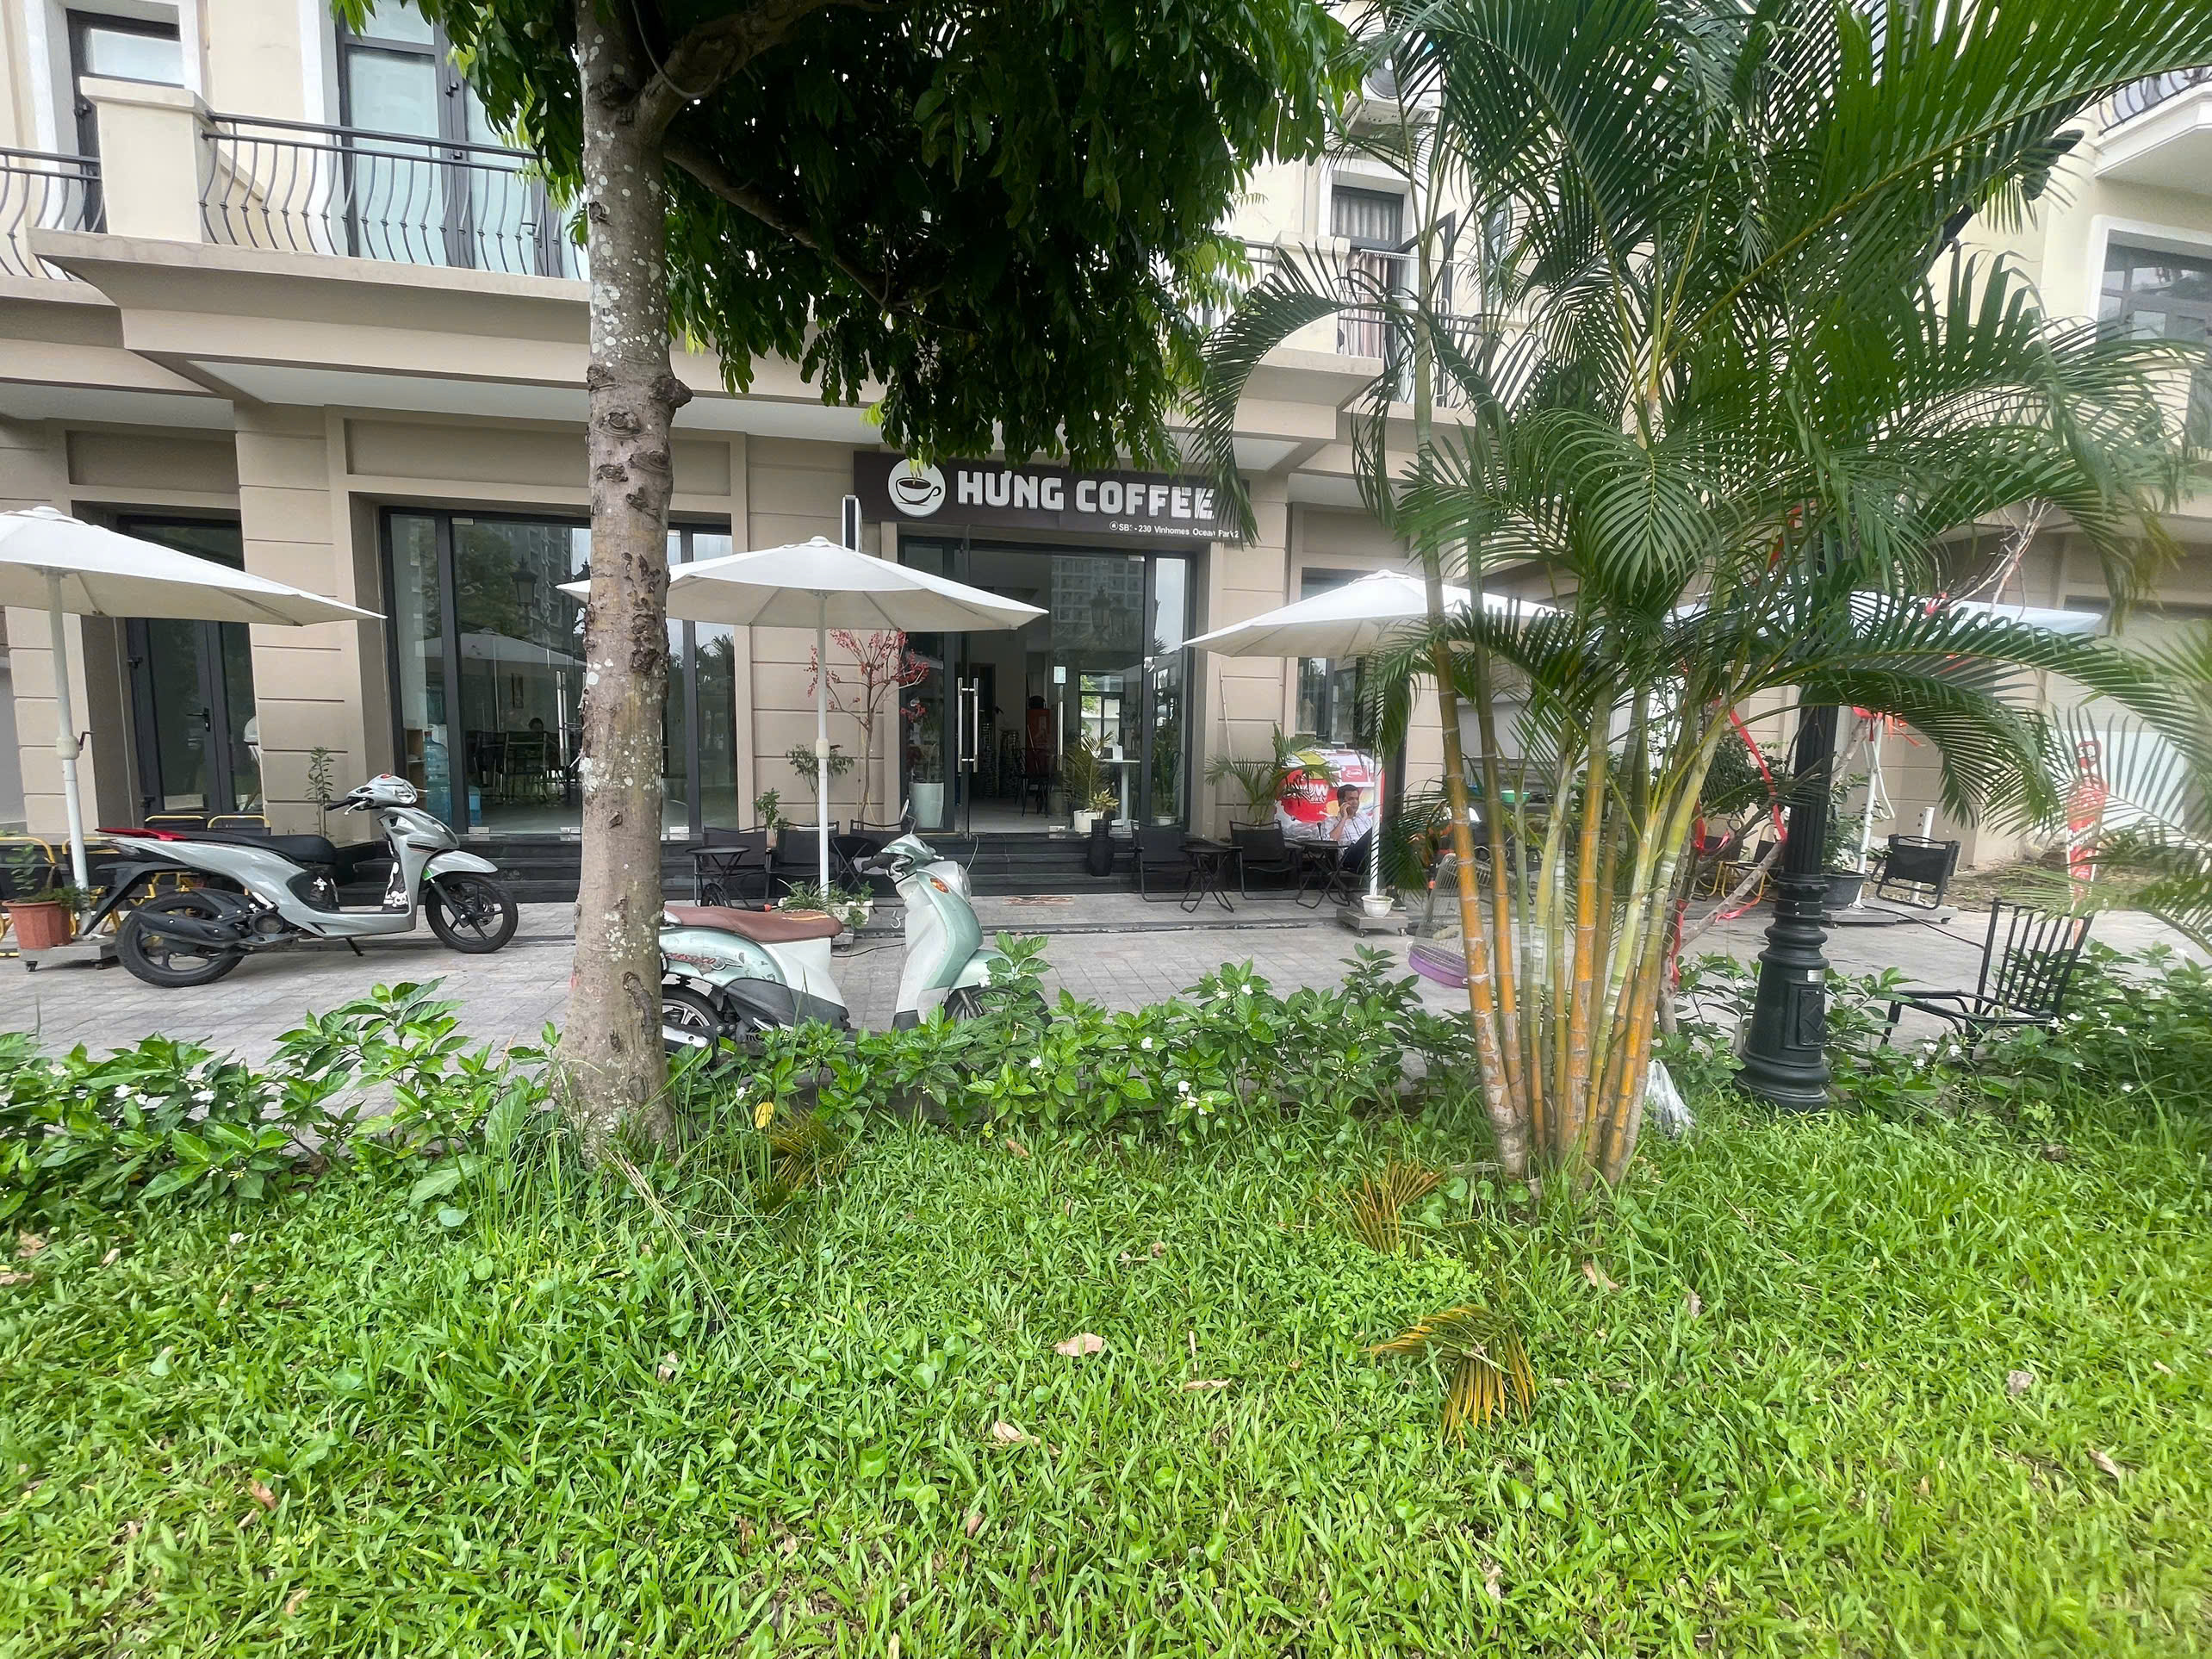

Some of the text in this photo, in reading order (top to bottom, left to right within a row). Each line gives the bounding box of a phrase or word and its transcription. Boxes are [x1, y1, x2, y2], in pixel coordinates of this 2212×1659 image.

[958, 470, 1215, 520] HƯNG COFFEE
[1138, 525, 1152, 533] 230
[1154, 525, 1190, 536] Vinhomes
[1192, 527, 1215, 537] Ocean
[1218, 529, 1234, 538] Park
